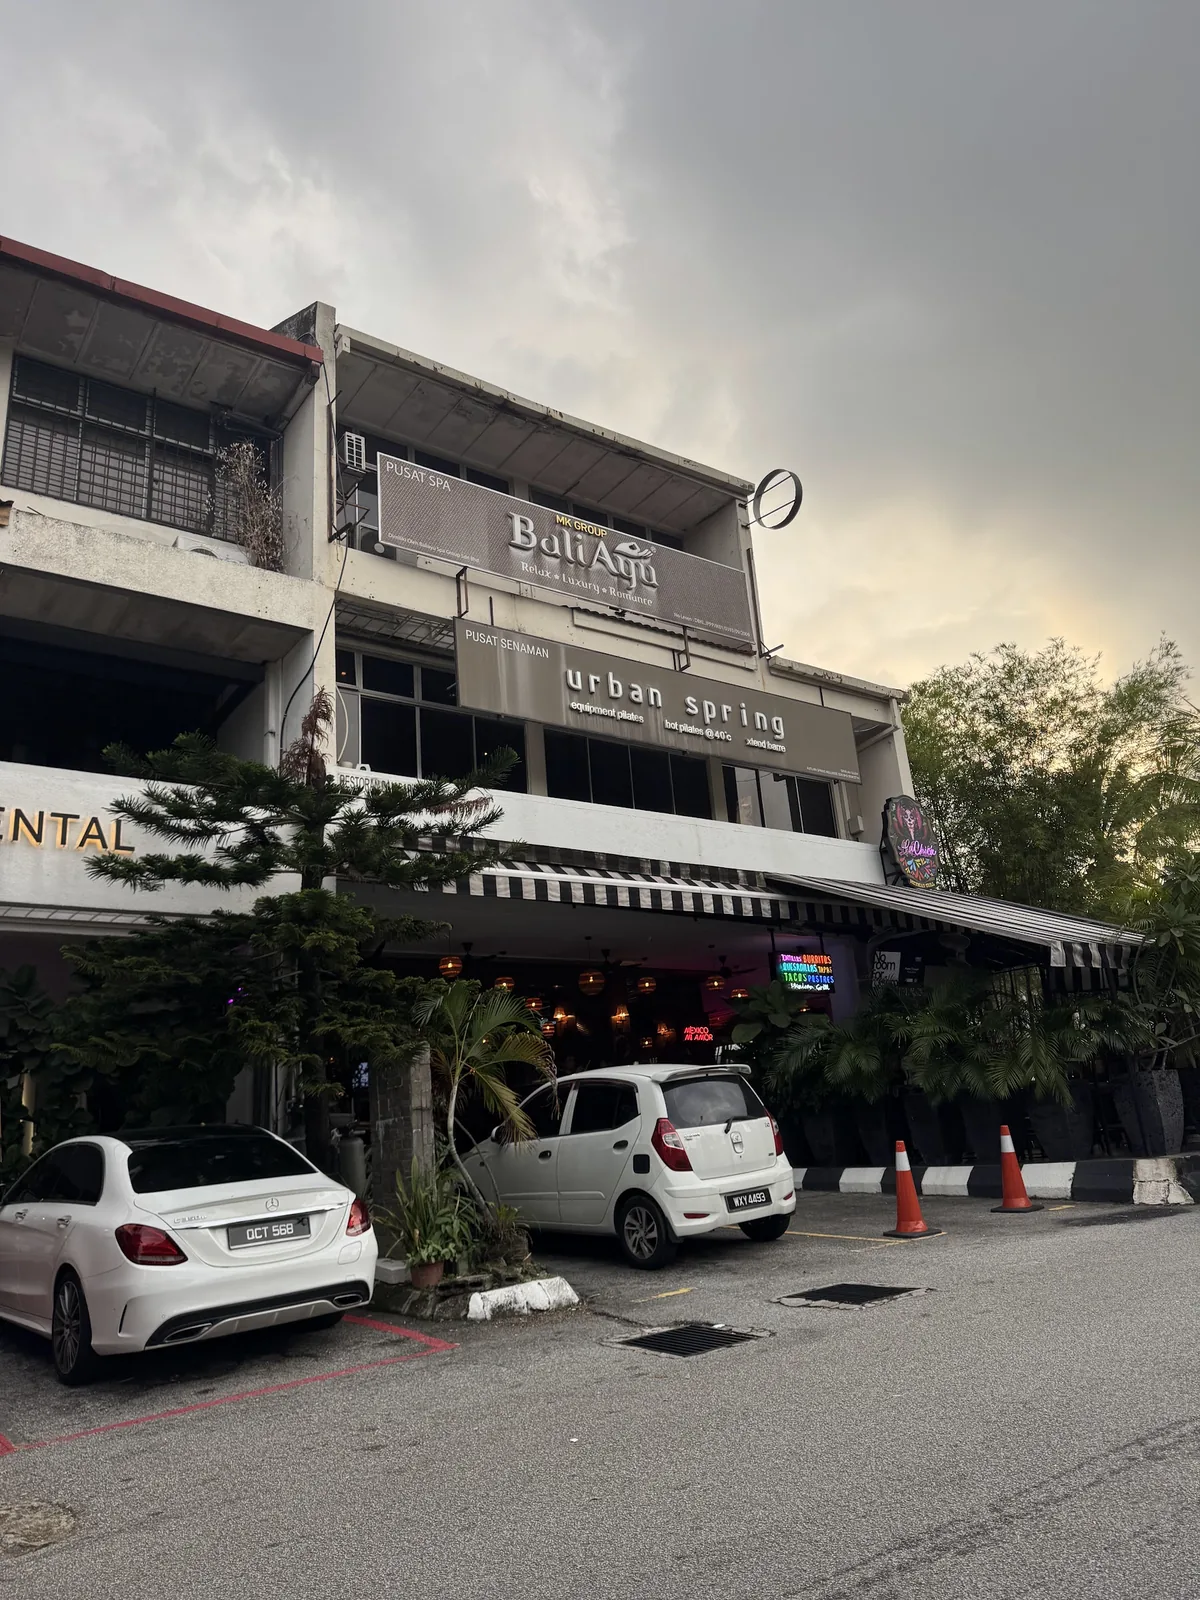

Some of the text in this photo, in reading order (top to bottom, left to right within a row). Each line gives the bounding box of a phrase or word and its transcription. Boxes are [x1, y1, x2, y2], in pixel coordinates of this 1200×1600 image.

[386, 461, 451, 492] PUSAT SPA
[556, 514, 608, 538] MK GROUP
[520, 561, 653, 606] Relax Luxury Romance
[465, 629, 549, 659] PUSAT SENAMAN
[566, 668, 785, 741] urban spring
[570, 700, 645, 724] equipment pilates
[664, 718, 678, 731] hot
[678, 722, 704, 737] pilates
[746, 737, 786, 753] xtend barre
[0, 807, 135, 852] NTAL
[802, 954, 832, 965] BURRITOS
[874, 950, 886, 962] No
[872, 961, 896, 971] room
[783, 972, 835, 983] TACOS POSTRES
[693, 1033, 714, 1042] AMOR
[733, 1192, 766, 1208] WXY 4493
[272, 1223, 294, 1237] 568
